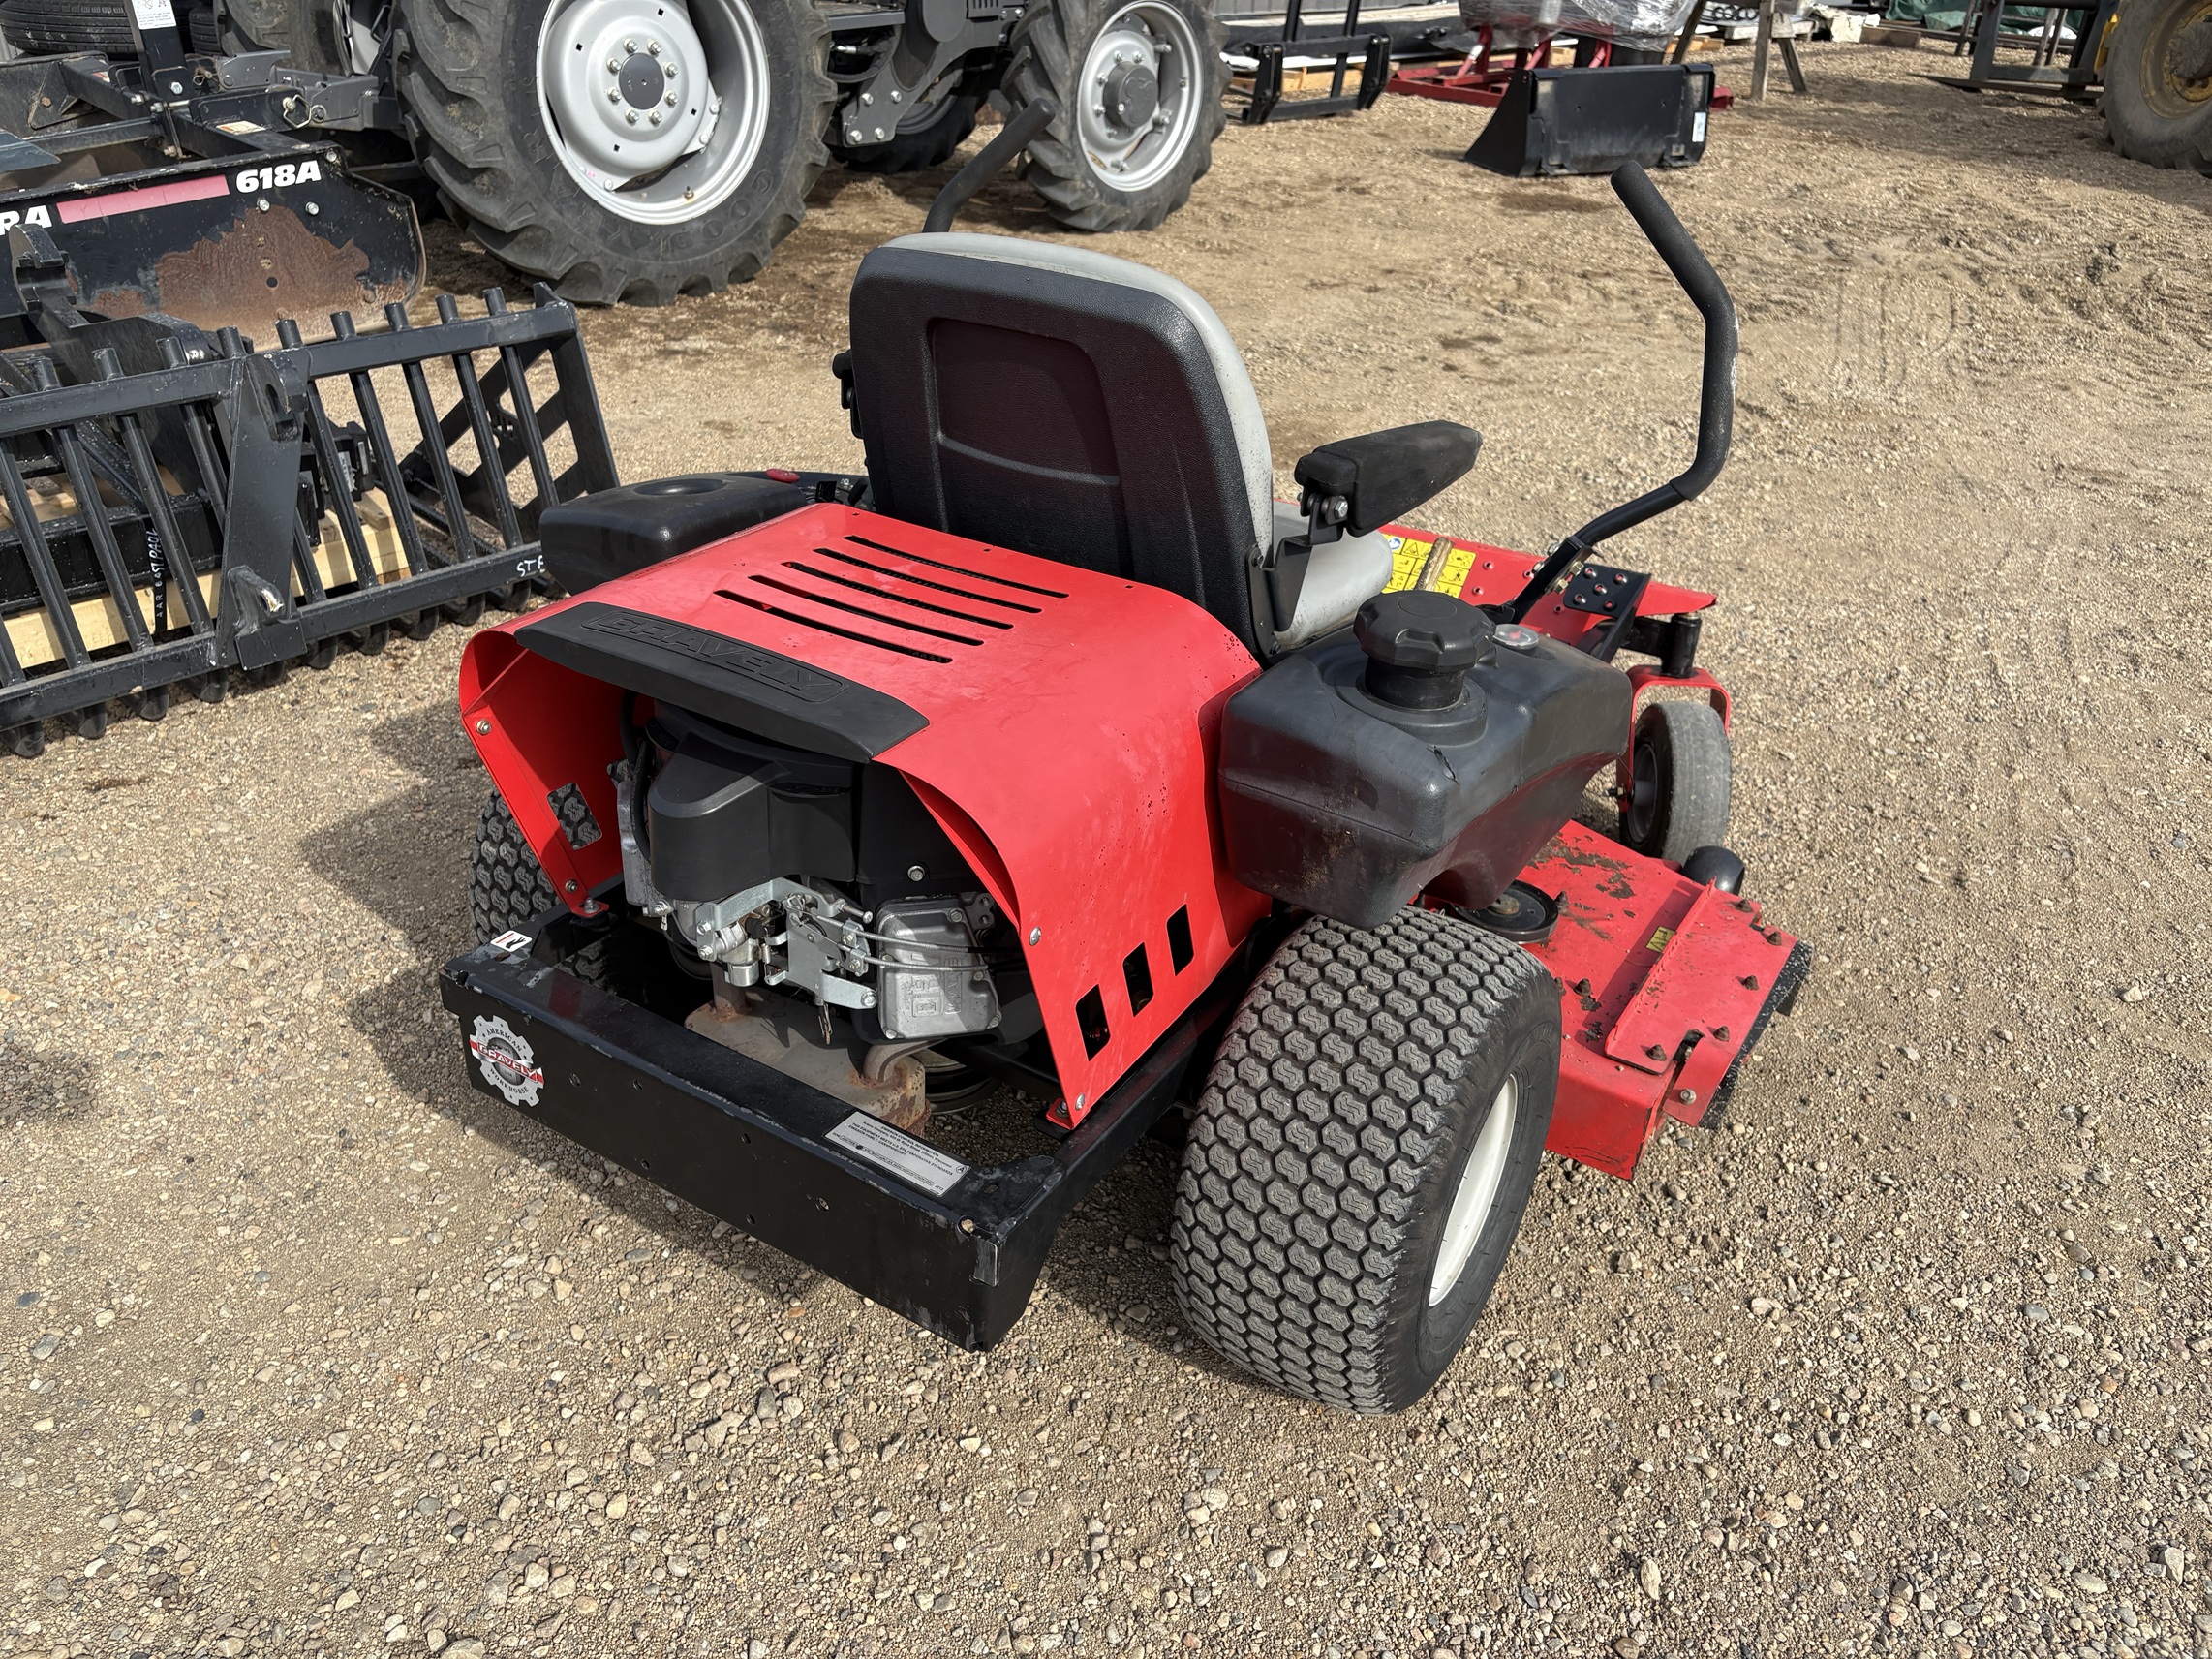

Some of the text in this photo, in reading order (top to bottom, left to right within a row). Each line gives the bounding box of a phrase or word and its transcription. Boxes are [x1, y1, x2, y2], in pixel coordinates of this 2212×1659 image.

[235, 160, 322, 194] 618A
[598, 616, 837, 691] GRAVELY
[486, 1027, 523, 1053] AMERICAN
[478, 1043, 538, 1079] GRAVELY
[490, 1067, 529, 1094] WORKHORSE
